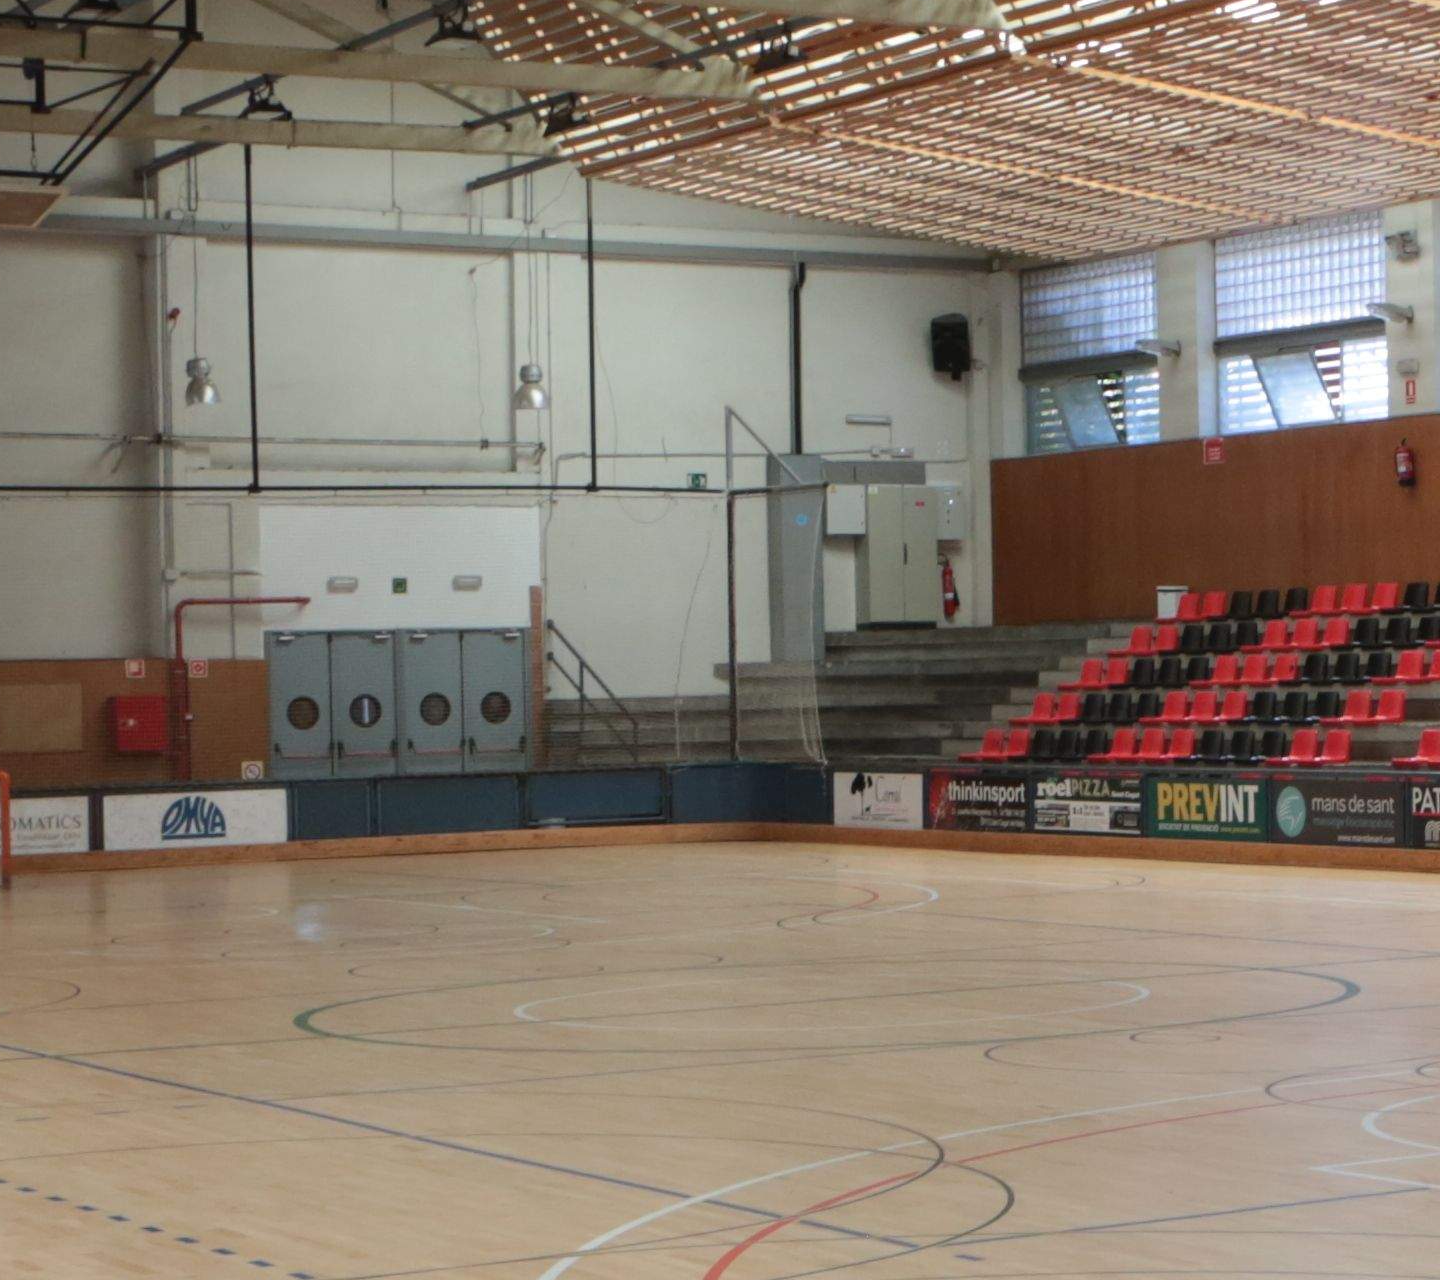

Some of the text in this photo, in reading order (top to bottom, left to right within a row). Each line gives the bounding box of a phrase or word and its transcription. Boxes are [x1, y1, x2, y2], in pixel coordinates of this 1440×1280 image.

[948, 780, 1025, 806] thinkinsport
[1157, 782, 1259, 823] PREVINT
[1312, 793, 1395, 815] mans de sant
